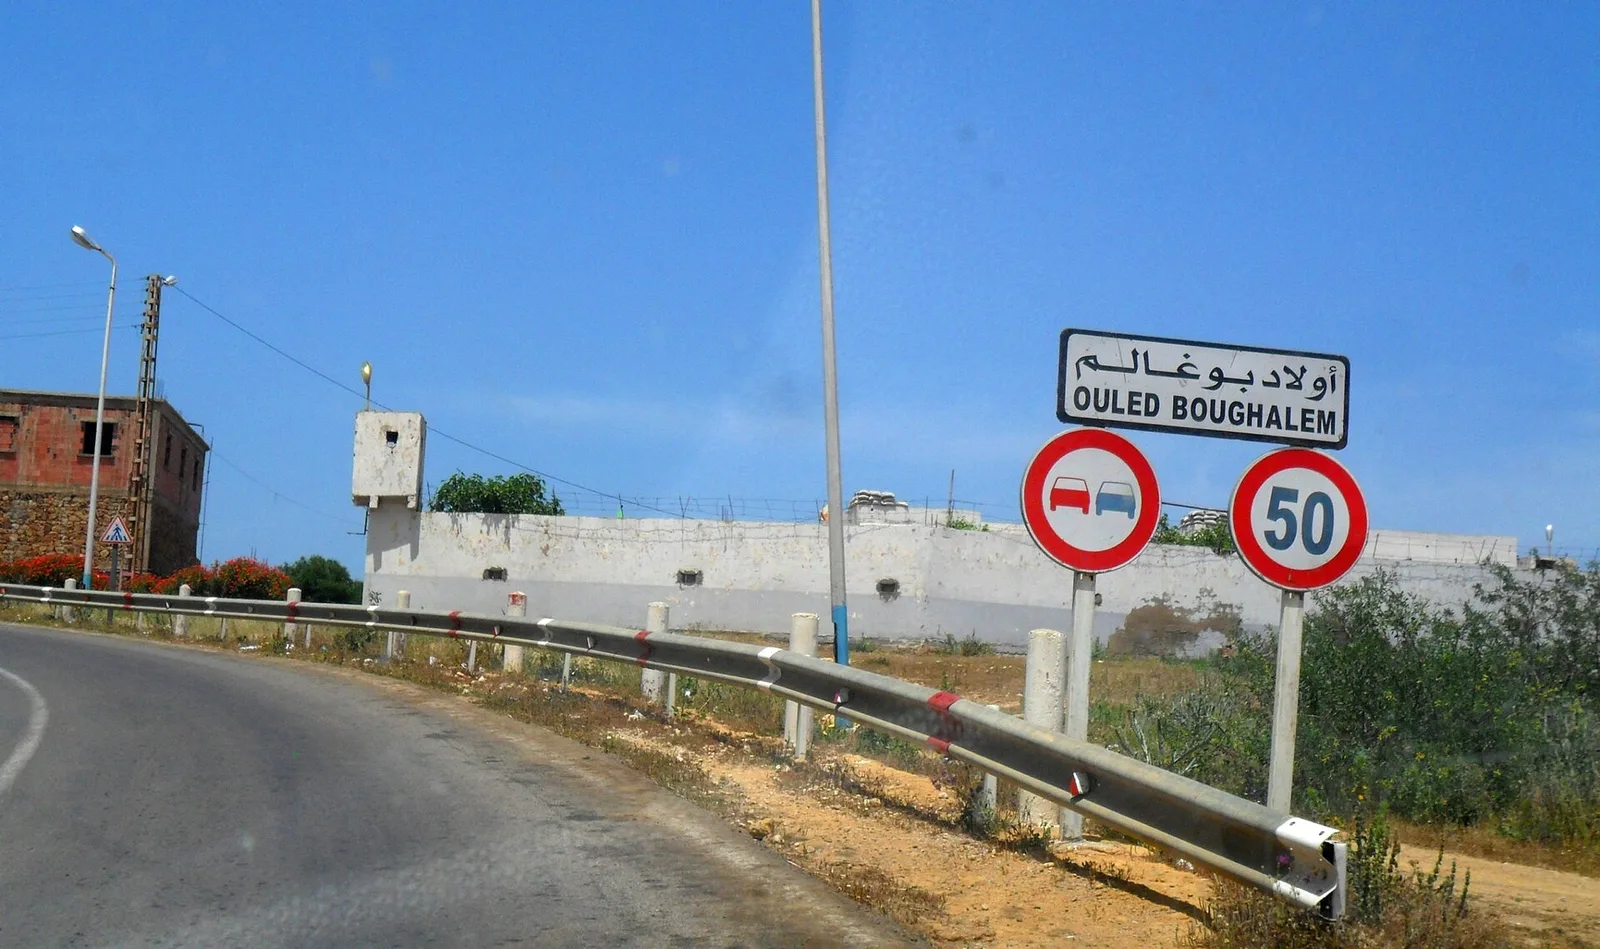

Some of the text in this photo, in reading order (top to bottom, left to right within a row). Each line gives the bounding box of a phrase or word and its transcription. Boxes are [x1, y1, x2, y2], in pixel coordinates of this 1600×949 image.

[1262, 365, 1337, 401] أولاد
[1073, 385, 1336, 436] OULED BOUGHALEM
[1264, 486, 1334, 555] 50
